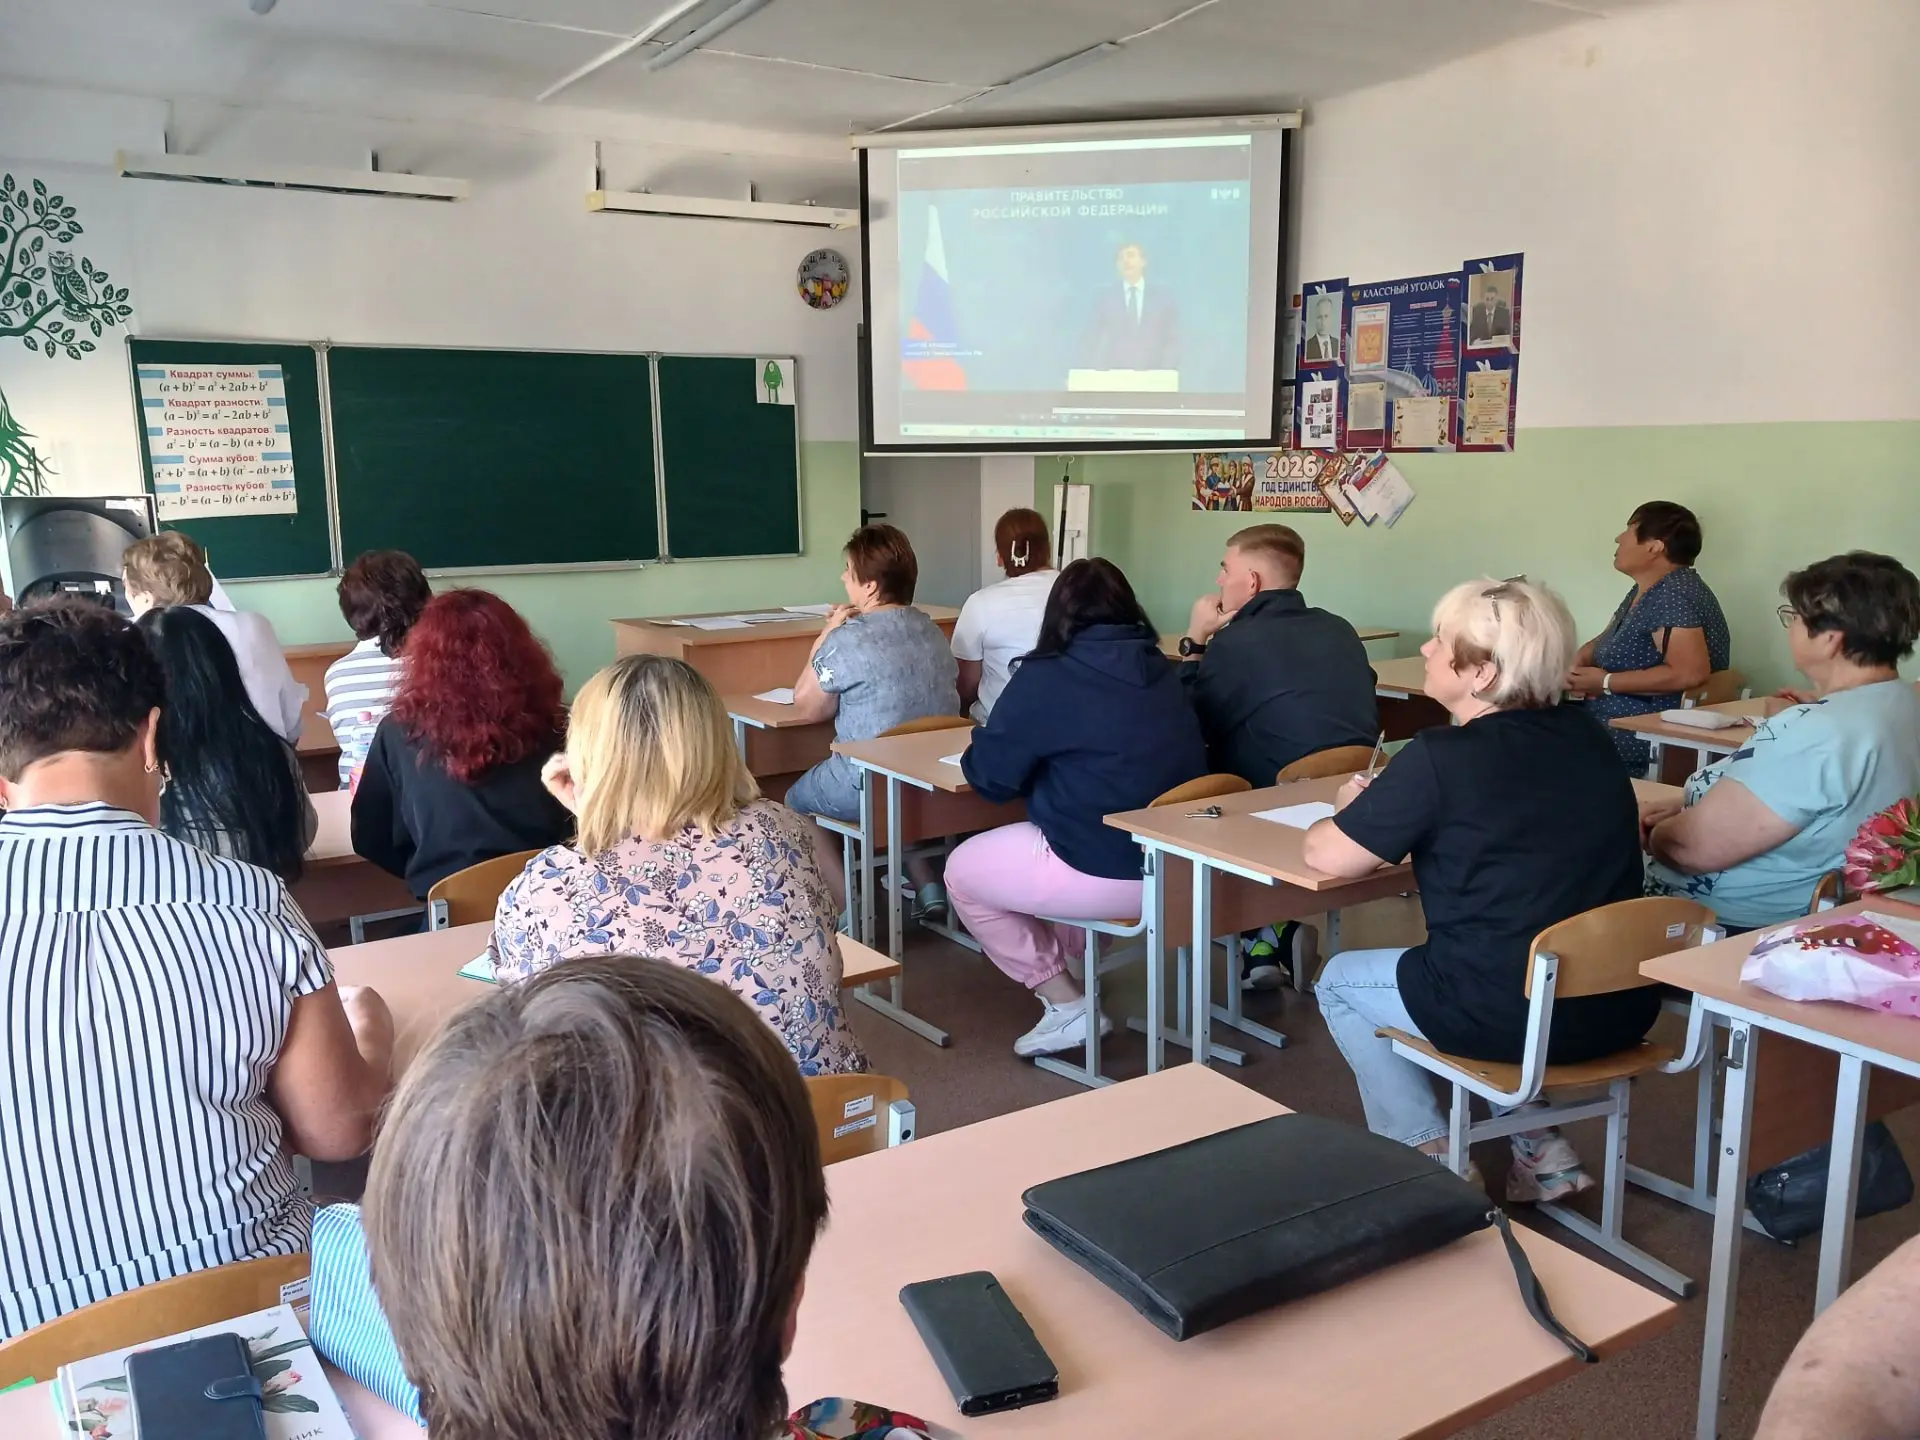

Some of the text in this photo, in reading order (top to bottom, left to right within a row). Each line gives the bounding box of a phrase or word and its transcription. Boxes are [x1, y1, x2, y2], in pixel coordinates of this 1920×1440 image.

[1010, 188, 1123, 202] ПРАВИТЕЛЬСТВО
[973, 203, 1168, 219] РОССИЙСКОЙ ФЕДЕРАЦИИ
[1363, 279, 1445, 298] КЛАССНЫЙ УГОЛОК
[169, 370, 255, 380] Квадрат суммы:
[168, 399, 264, 408] Квадрат разности:
[189, 455, 258, 465] Сумма кубов:
[1266, 455, 1319, 478] 2026
[186, 484, 233, 492] Разность
[1261, 481, 1276, 493] ГОД
[1255, 495, 1329, 508] НАРОДОВ РОССИИ
